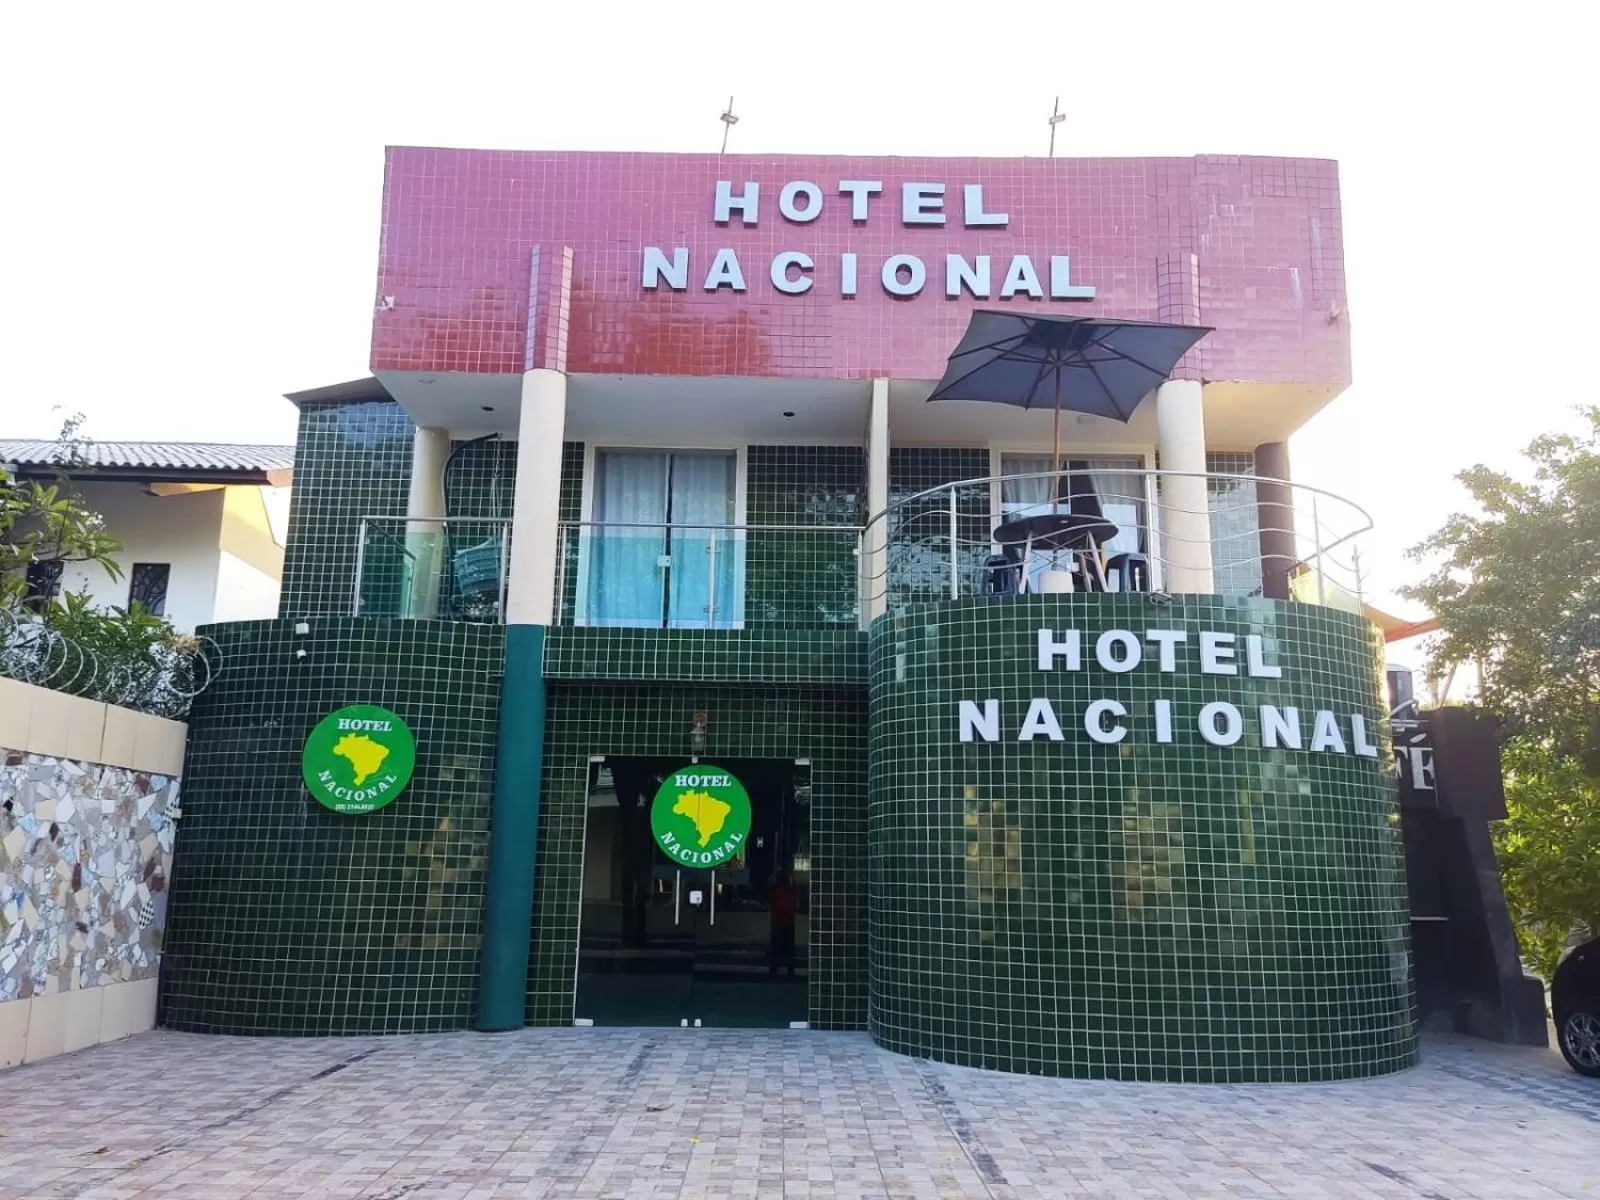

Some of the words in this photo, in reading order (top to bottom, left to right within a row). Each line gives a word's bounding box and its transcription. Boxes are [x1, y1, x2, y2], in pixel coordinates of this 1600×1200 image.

[713, 179, 1009, 228] HOTEL
[642, 246, 1096, 299] NACIONAL
[1037, 628, 1283, 679] HOTEL
[337, 718, 393, 732] HOTEL
[958, 697, 1379, 759] NACIONAL
[318, 769, 397, 802] NACIONAL
[674, 774, 732, 787] HOTEL
[660, 831, 743, 864] NACIONAL
